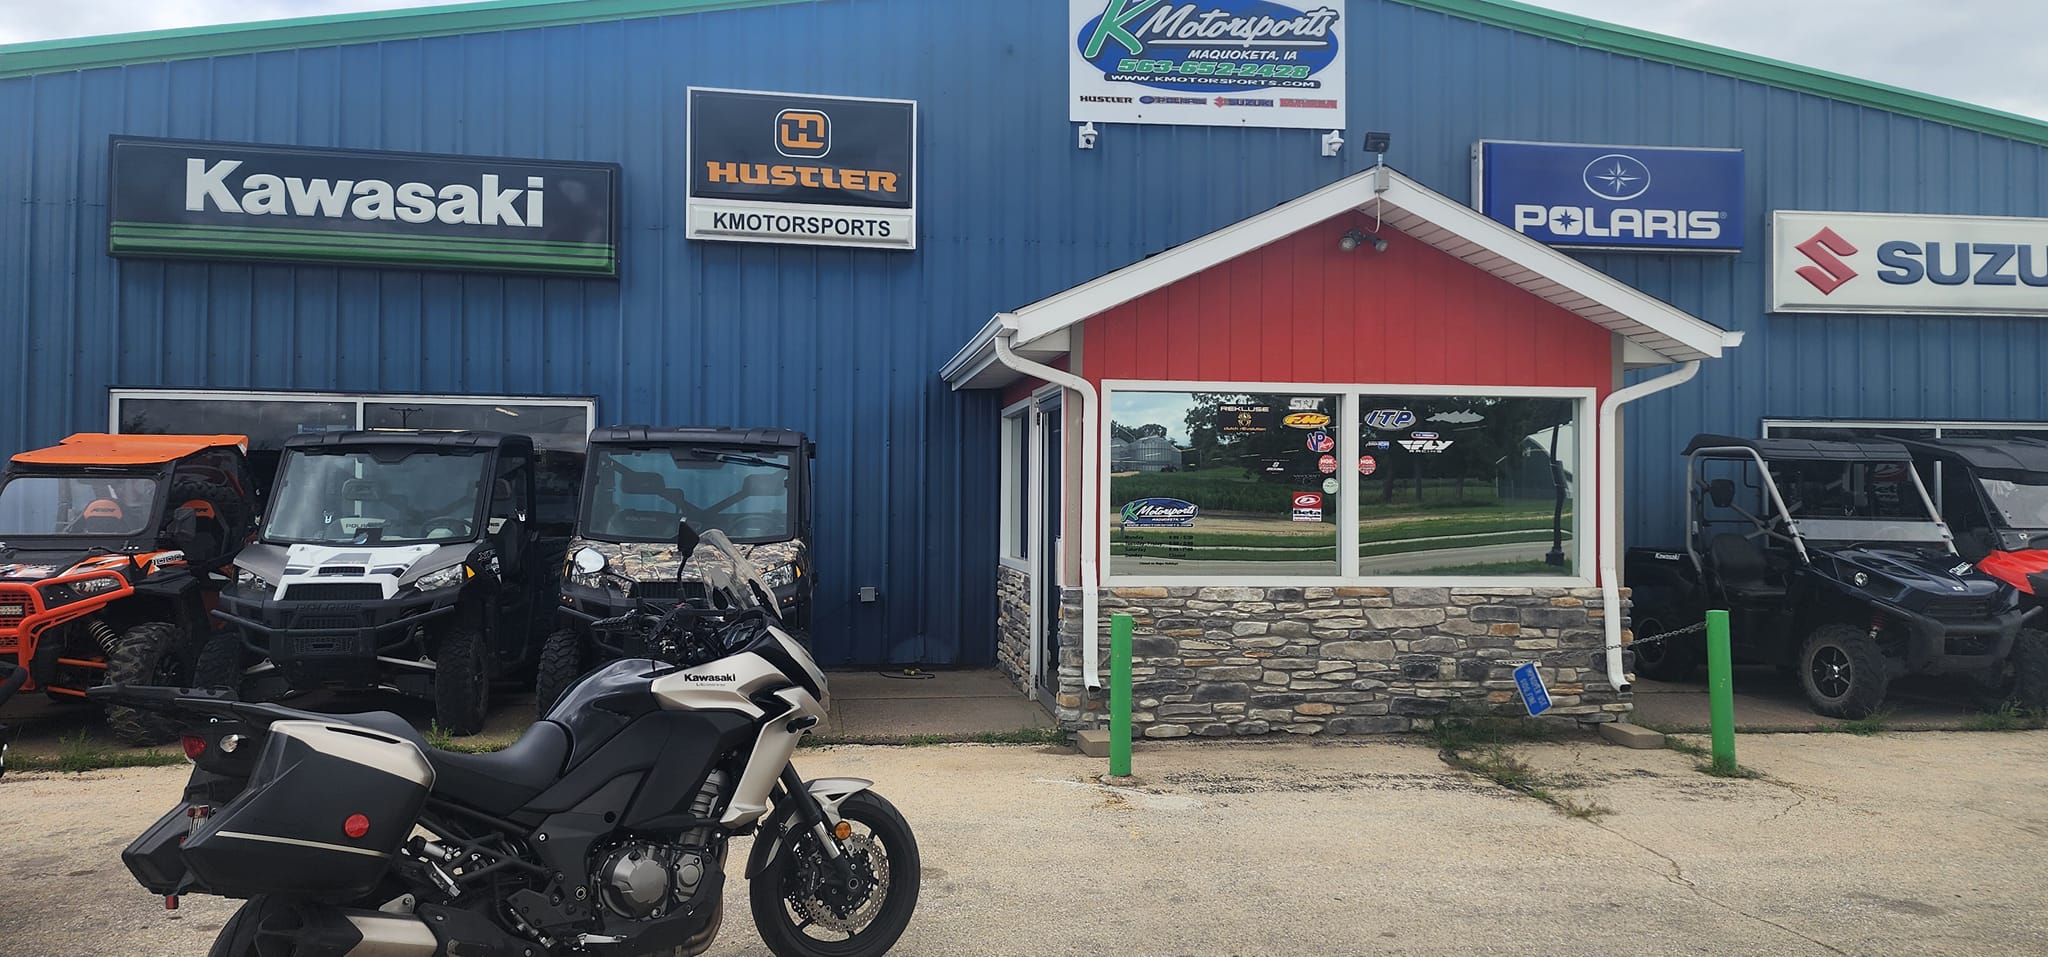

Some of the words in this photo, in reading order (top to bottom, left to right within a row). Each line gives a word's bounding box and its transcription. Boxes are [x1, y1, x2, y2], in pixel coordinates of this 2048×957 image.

[1188, 50, 1279, 61] MAQUOKETA,
[1284, 51, 1298, 60] IA
[1117, 59, 1310, 79] 563-652-2428
[1111, 74, 1315, 88] WWW.KMOTORSPORTS.COM
[1080, 95, 1133, 103] HUSTLER
[706, 161, 897, 193] HUSTLER
[185, 157, 544, 228] Kawasaki
[713, 212, 891, 237] KMOTORSPORTS
[1514, 204, 1721, 240] POLARIS
[1285, 415, 1330, 425] FMF
[1366, 409, 1413, 427] ITP
[1307, 432, 1326, 451] VP
[684, 674, 736, 682] Kawasaki
